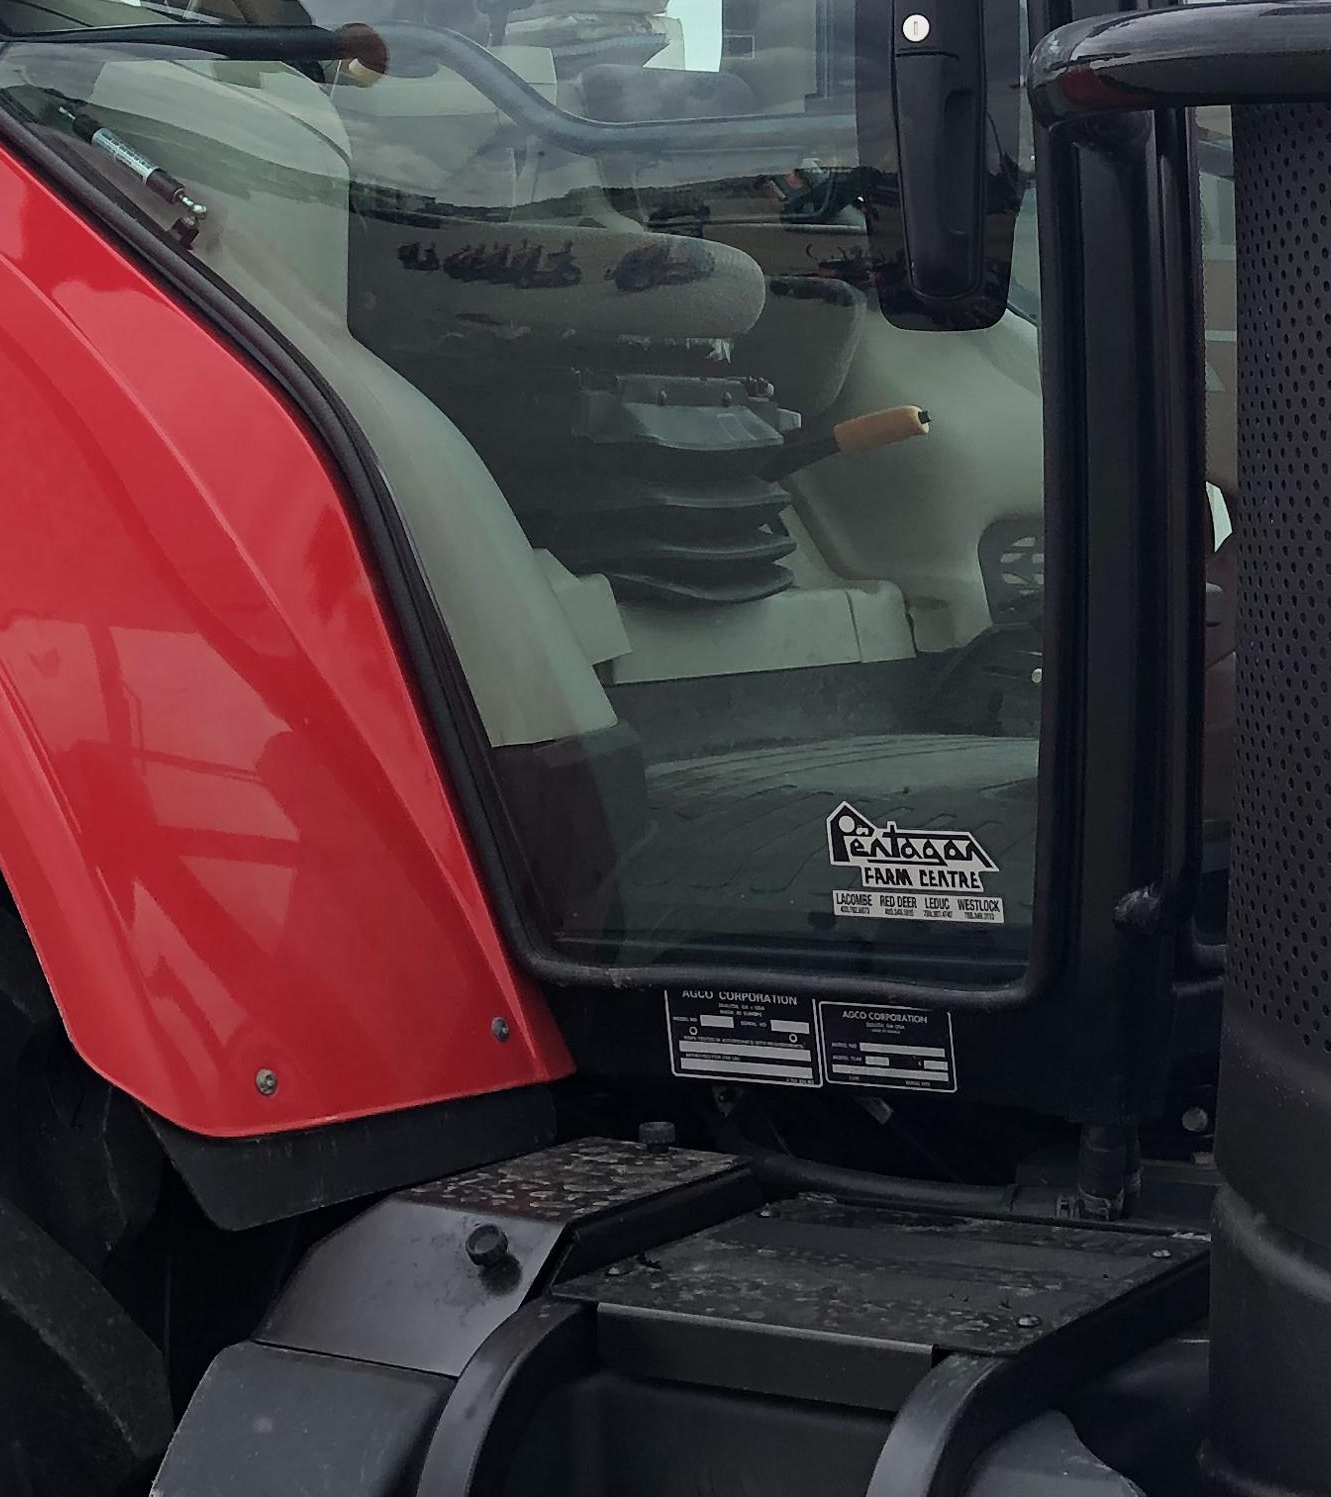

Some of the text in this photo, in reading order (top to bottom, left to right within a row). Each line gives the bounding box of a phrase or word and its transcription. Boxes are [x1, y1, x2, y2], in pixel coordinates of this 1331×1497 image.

[864, 867, 982, 889] FARM CENTRE
[835, 893, 1001, 912] LACOMBE RED DEER LEDUC WESTLOCK
[682, 990, 798, 1006] AGCO CORPORATION
[842, 1010, 928, 1024] AGCO CORPORATION
